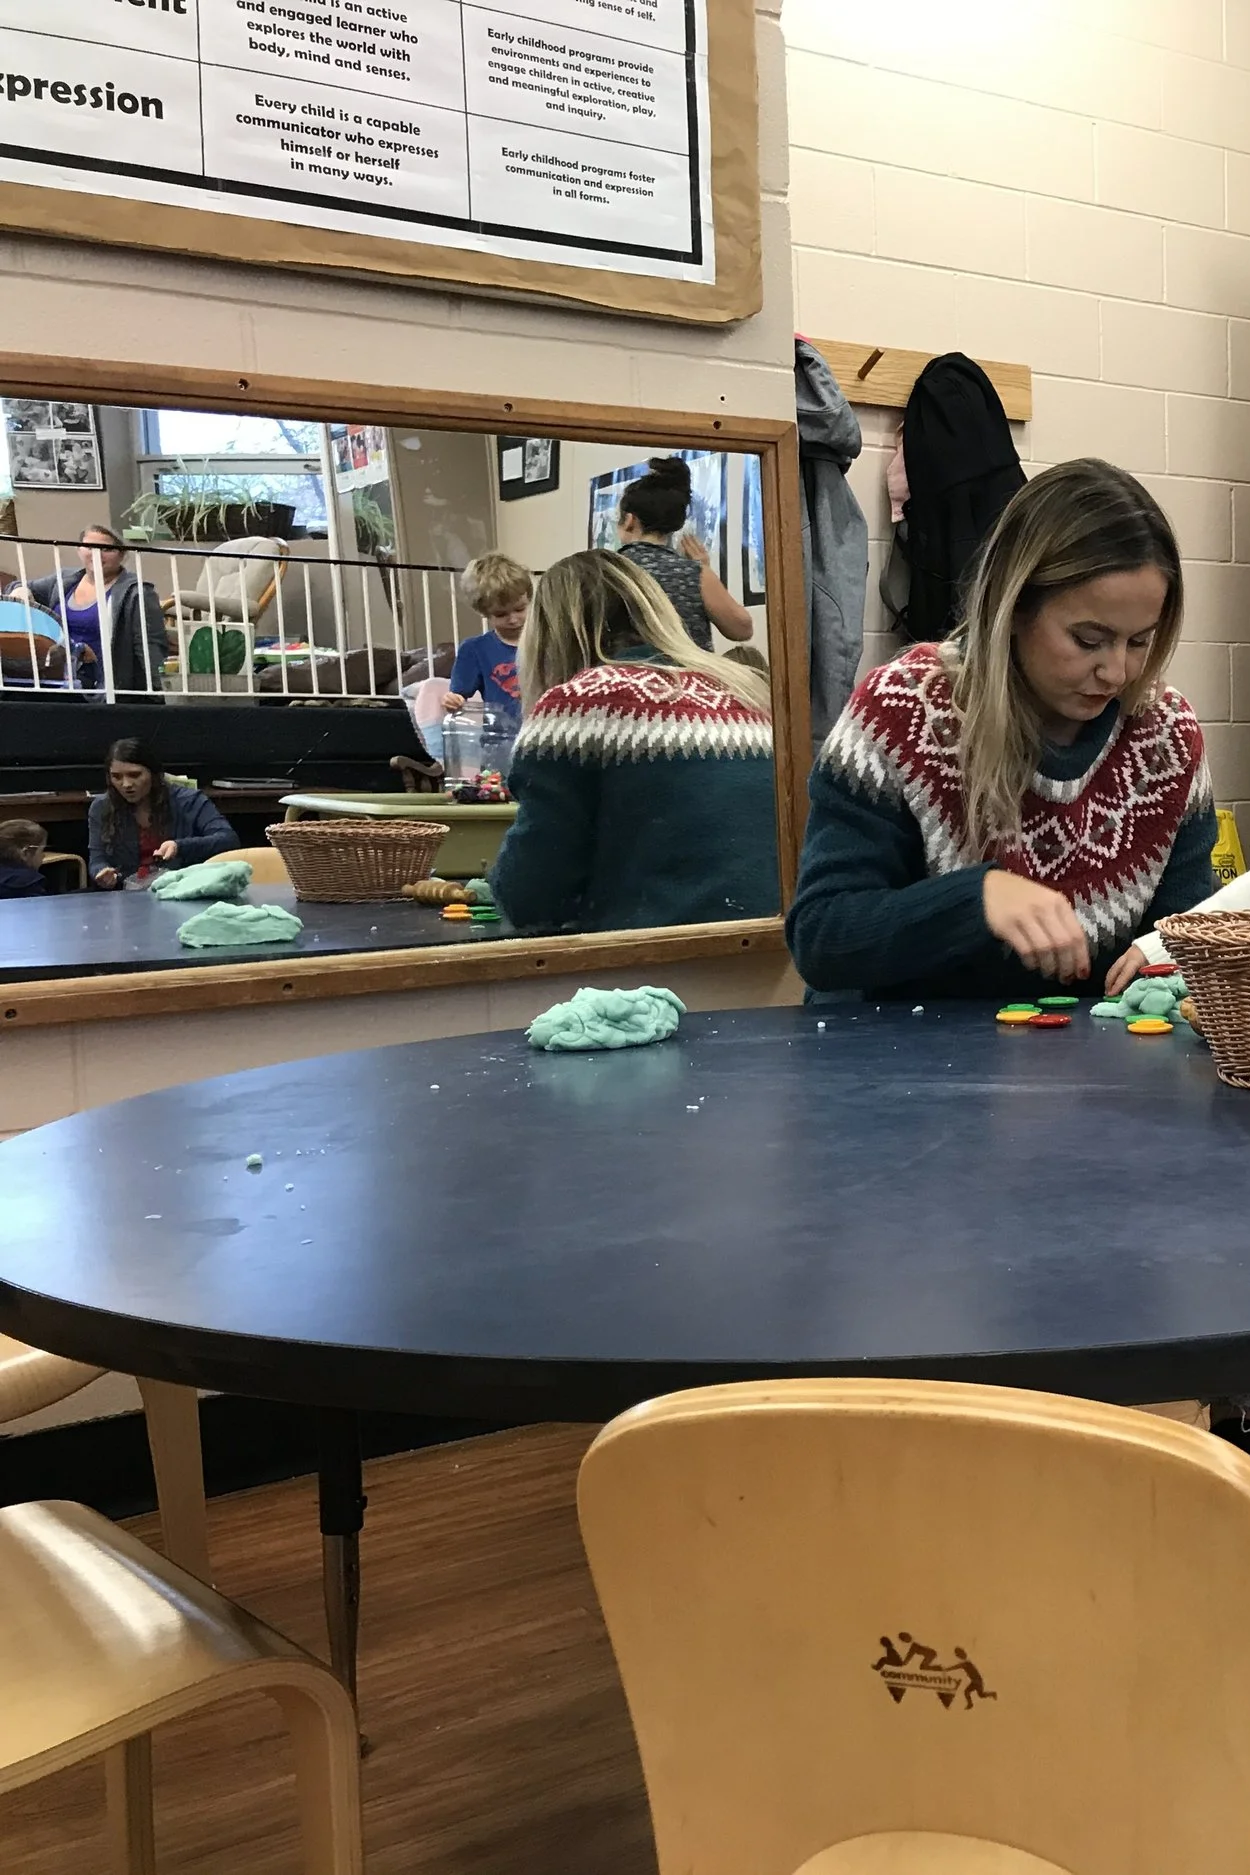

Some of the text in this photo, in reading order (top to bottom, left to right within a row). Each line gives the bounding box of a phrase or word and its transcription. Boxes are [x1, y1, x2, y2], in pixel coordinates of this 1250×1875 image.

[236, 0, 419, 44] and engaged learner who
[345, 1, 362, 13] an
[367, 5, 408, 23] active
[625, 7, 634, 16] of
[637, 11, 656, 21] self.
[247, 20, 411, 62] explores the world with
[249, 37, 411, 81] body, mind and senses.
[487, 28, 654, 74] Early childhood programs provide
[488, 60, 656, 103] engage children in active, creative
[491, 46, 651, 87] environments and experiences to
[0, 73, 164, 119] pression
[255, 94, 421, 136] Every child is a capable
[489, 74, 657, 118] and meaningful exploration, play,
[546, 101, 606, 121] and inquiry.
[236, 113, 439, 159] communicator who expresses
[280, 138, 400, 170] himself or herself
[291, 158, 393, 186] in many ways.
[502, 147, 656, 184] Early childhood programs foster
[505, 164, 654, 197] communication and expression
[553, 187, 610, 204] in all forms.
